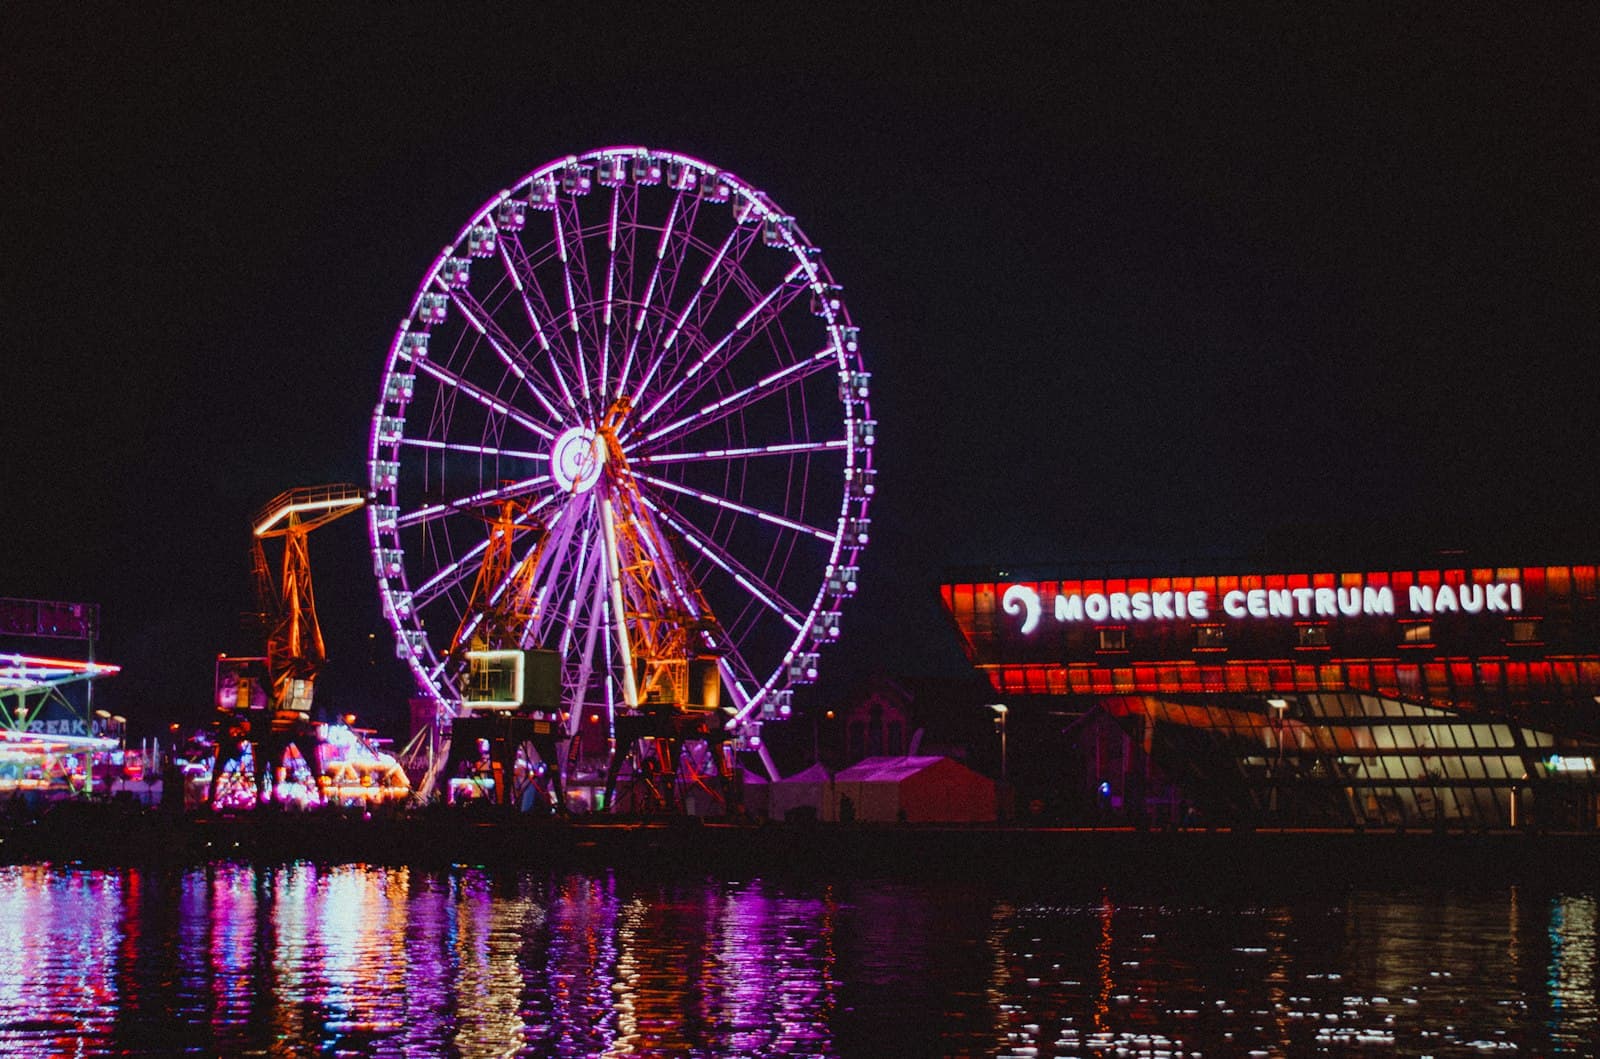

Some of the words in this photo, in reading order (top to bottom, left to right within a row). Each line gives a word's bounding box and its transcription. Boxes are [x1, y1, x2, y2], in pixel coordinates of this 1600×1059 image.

[1055, 591, 1208, 621] MORSKIE
[1223, 587, 1394, 617] CENTRUM
[1409, 583, 1522, 612] NAUKI
[14, 720, 87, 735] REAK
